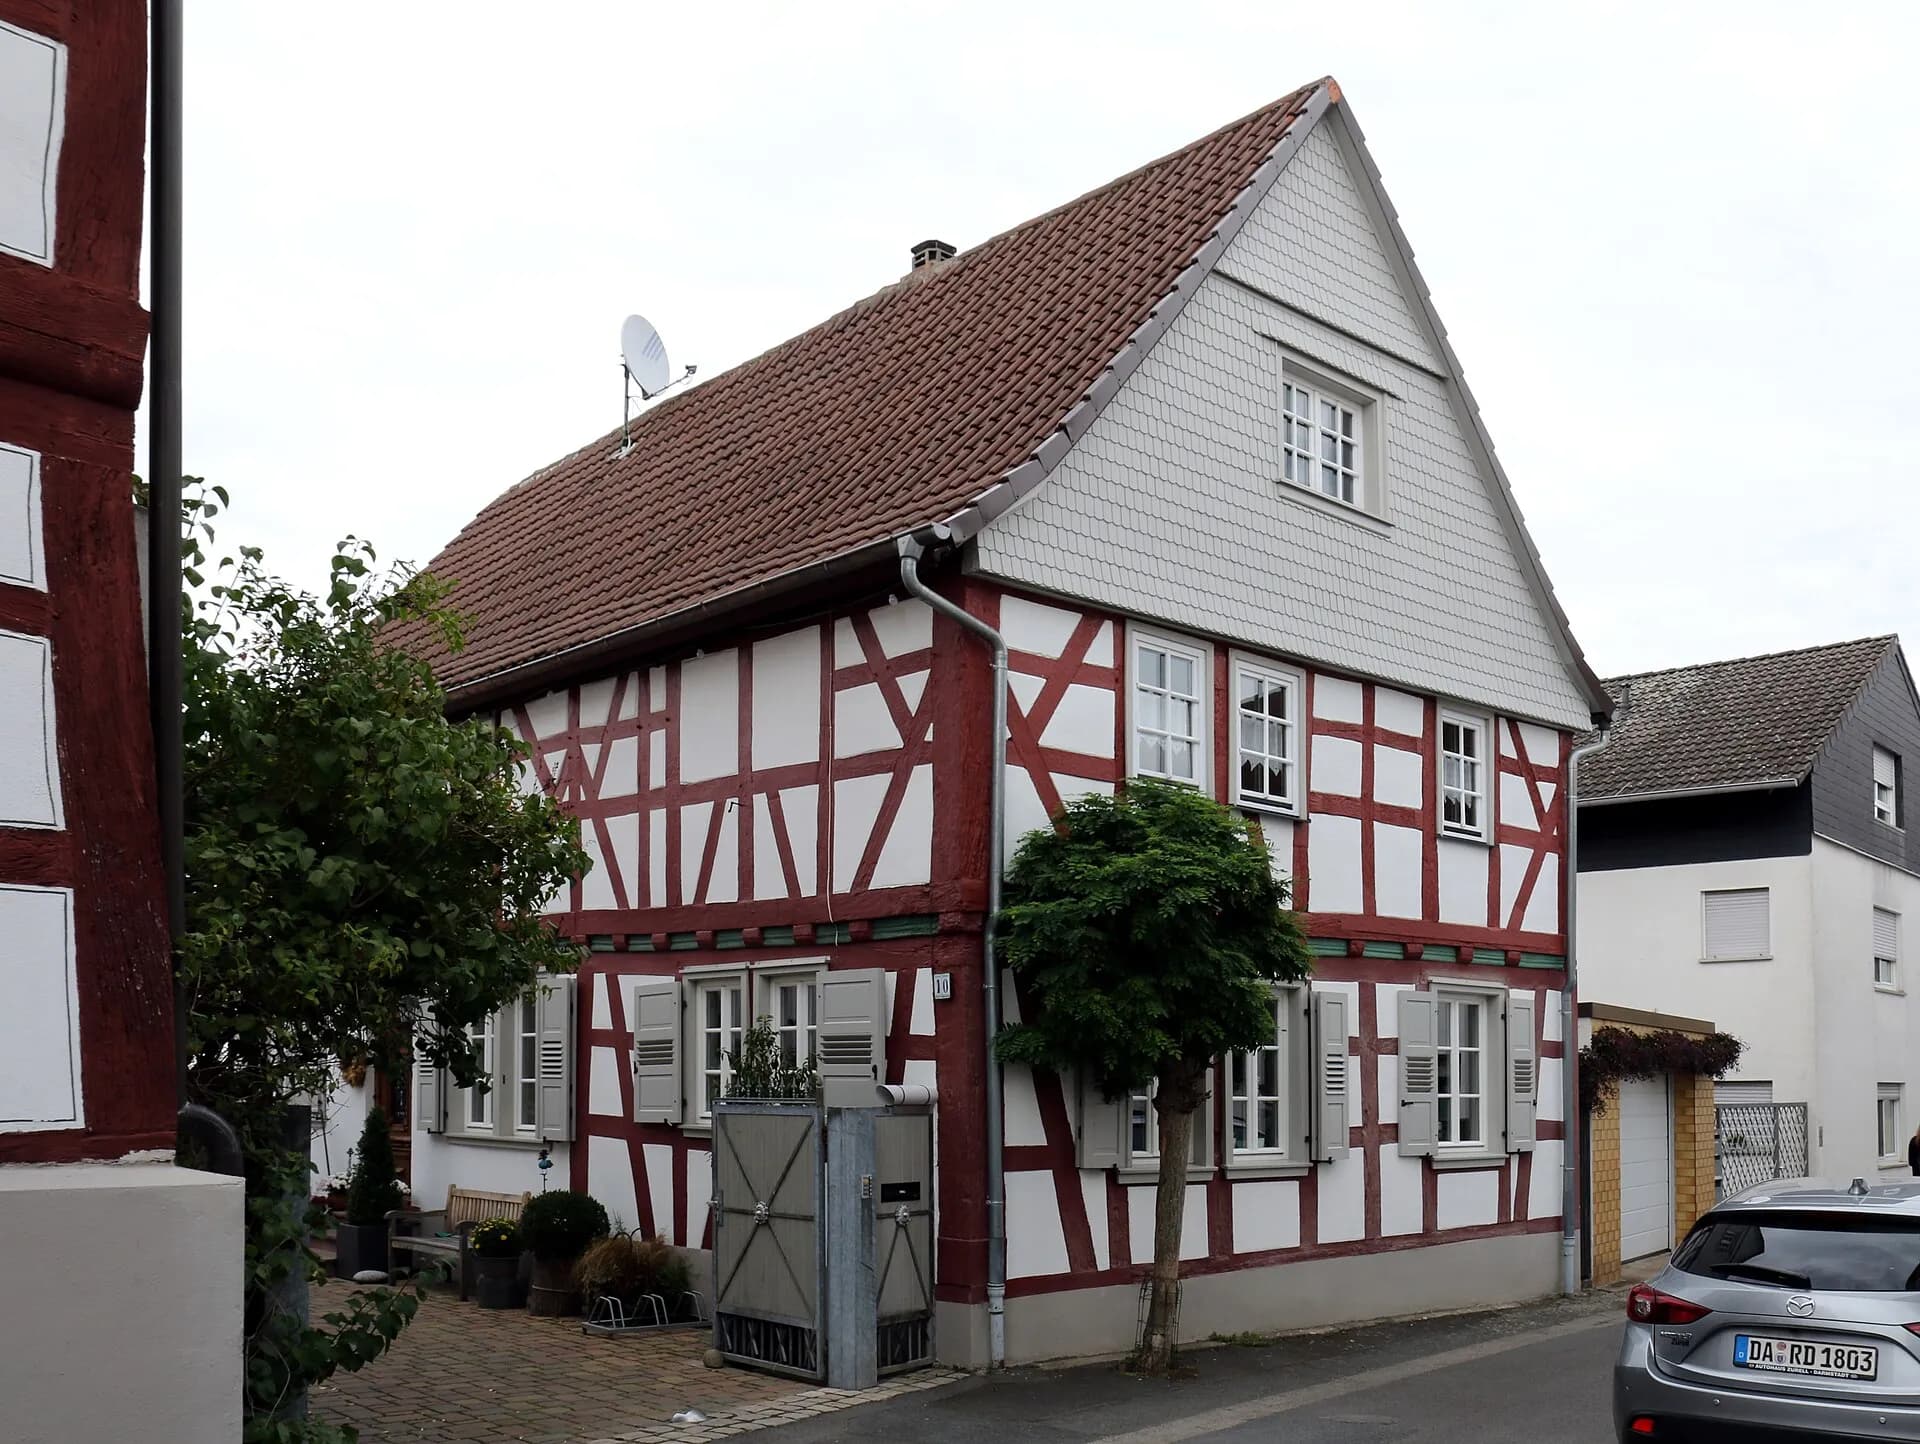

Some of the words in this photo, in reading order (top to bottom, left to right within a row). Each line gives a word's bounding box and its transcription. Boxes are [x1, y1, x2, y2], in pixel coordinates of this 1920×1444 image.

[936, 979, 948, 994] 10
[1749, 1340, 1773, 1362] DA
[1789, 1344, 1816, 1366] RD
[1820, 1347, 1873, 1372] 1803
[1755, 1363, 1786, 1372] AUTOHAUS
